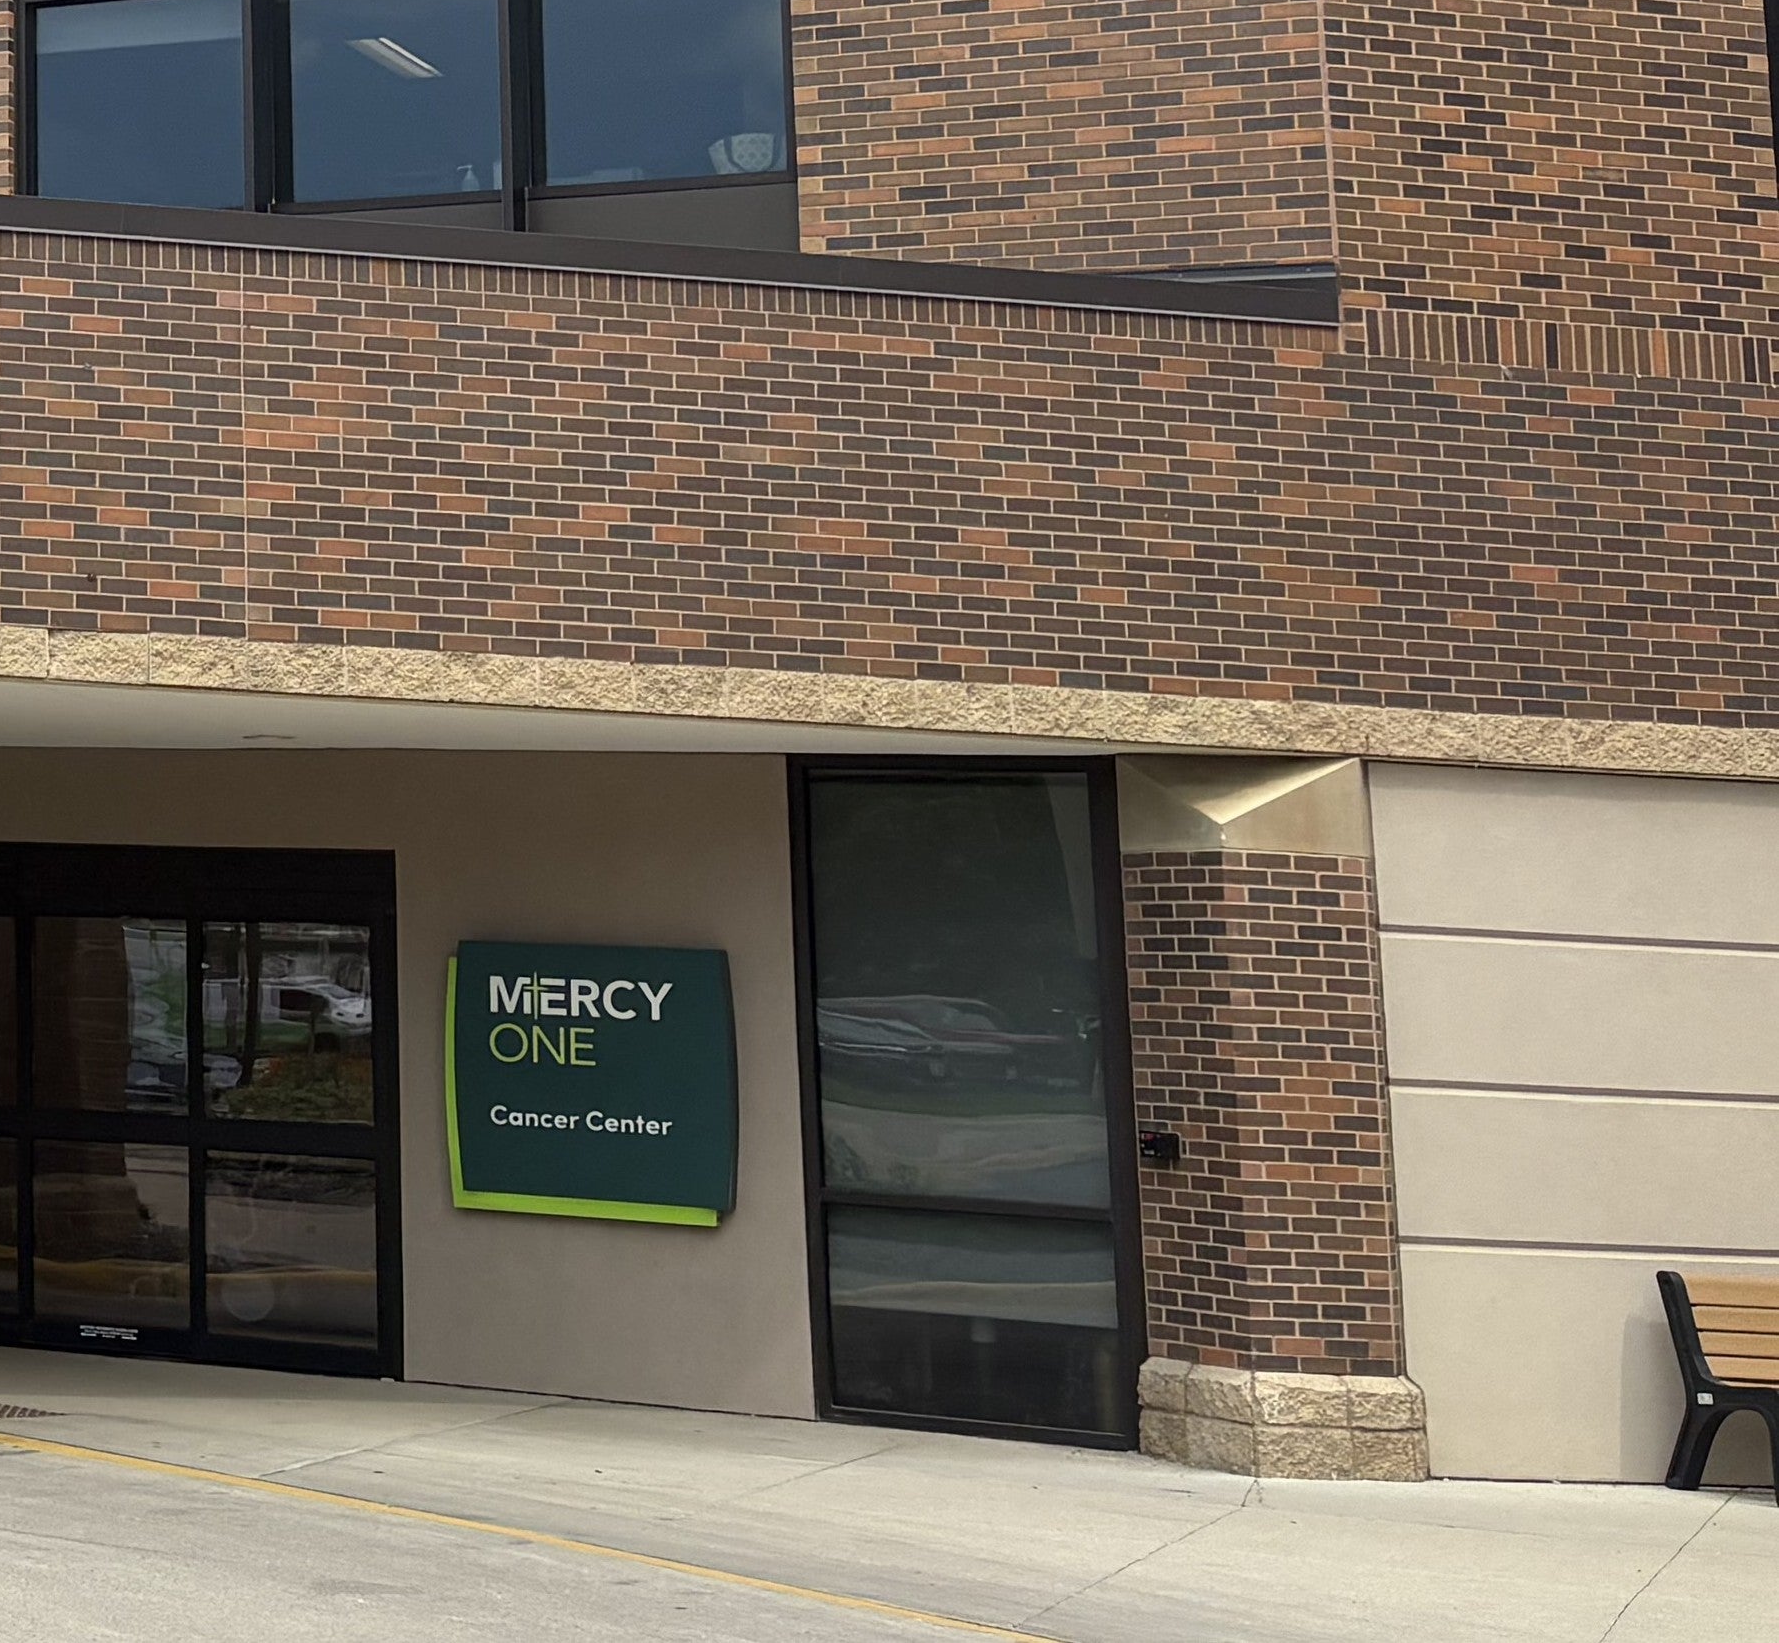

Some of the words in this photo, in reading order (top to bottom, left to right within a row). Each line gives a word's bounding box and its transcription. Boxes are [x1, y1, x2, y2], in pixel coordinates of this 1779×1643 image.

[489, 971, 673, 1021] MERCY
[489, 1022, 597, 1066] ONE
[489, 1105, 580, 1129] Cancer
[585, 1110, 673, 1135] Center
